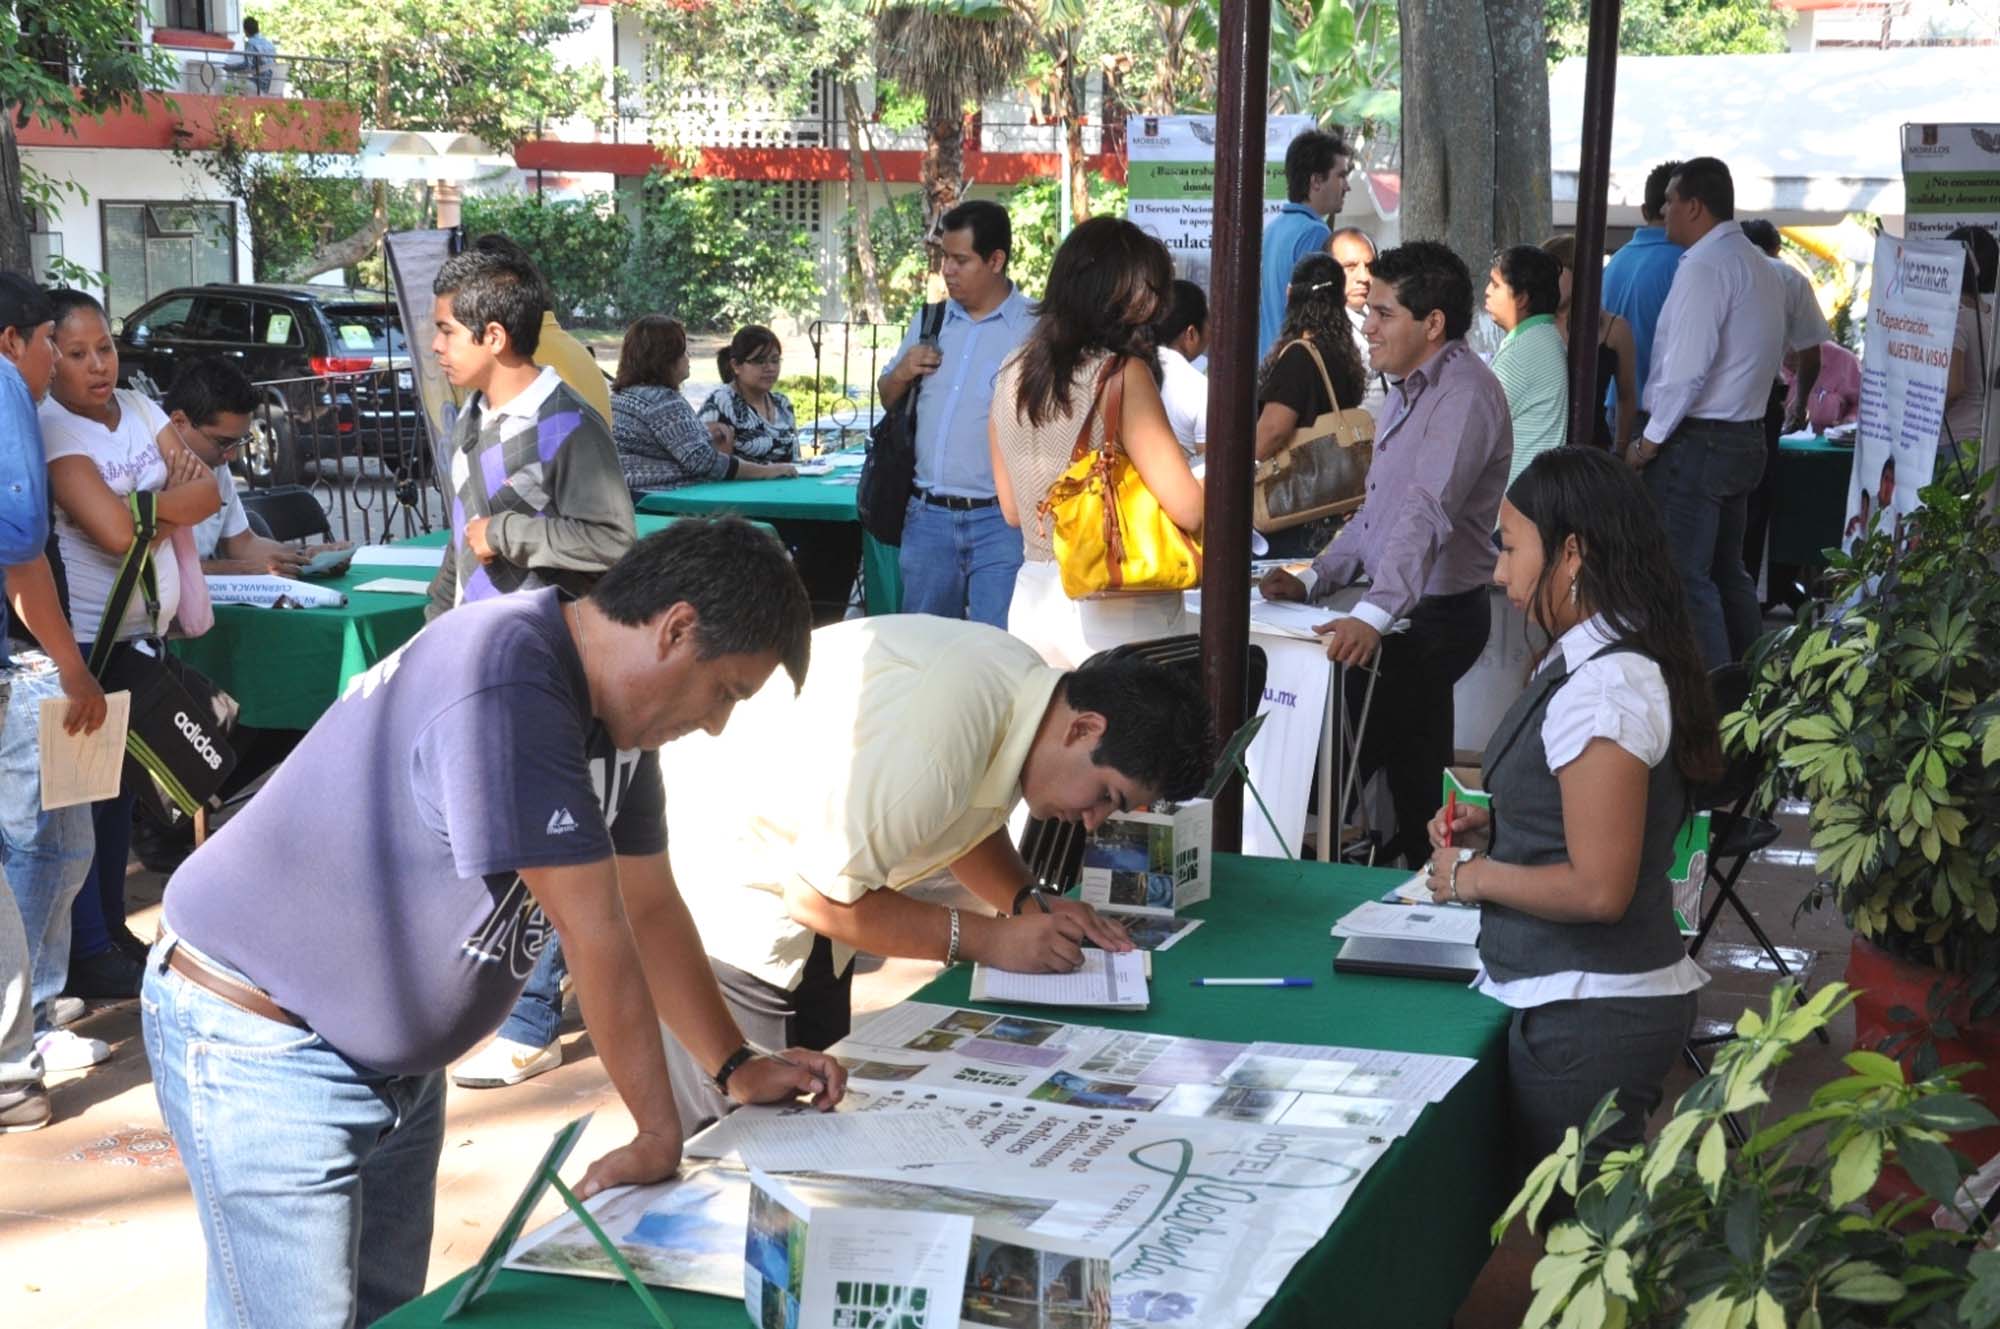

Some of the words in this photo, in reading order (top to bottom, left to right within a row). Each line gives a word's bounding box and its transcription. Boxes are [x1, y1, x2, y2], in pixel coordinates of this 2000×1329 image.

[1134, 204, 1144, 213] El
[1146, 204, 1180, 213] Servicio
[1182, 204, 1214, 213] Nacion
[1164, 232, 1213, 249] culaci
[1918, 221, 1954, 232] Servicio
[1887, 340, 1924, 364] NUESTRA
[1925, 346, 1949, 368] VISIÓ
[174, 711, 222, 770] adidas
[980, 1118, 1025, 1148] Alber
[1005, 1115, 1069, 1156] Jardines
[1229, 1131, 1297, 1177] HOTEL
